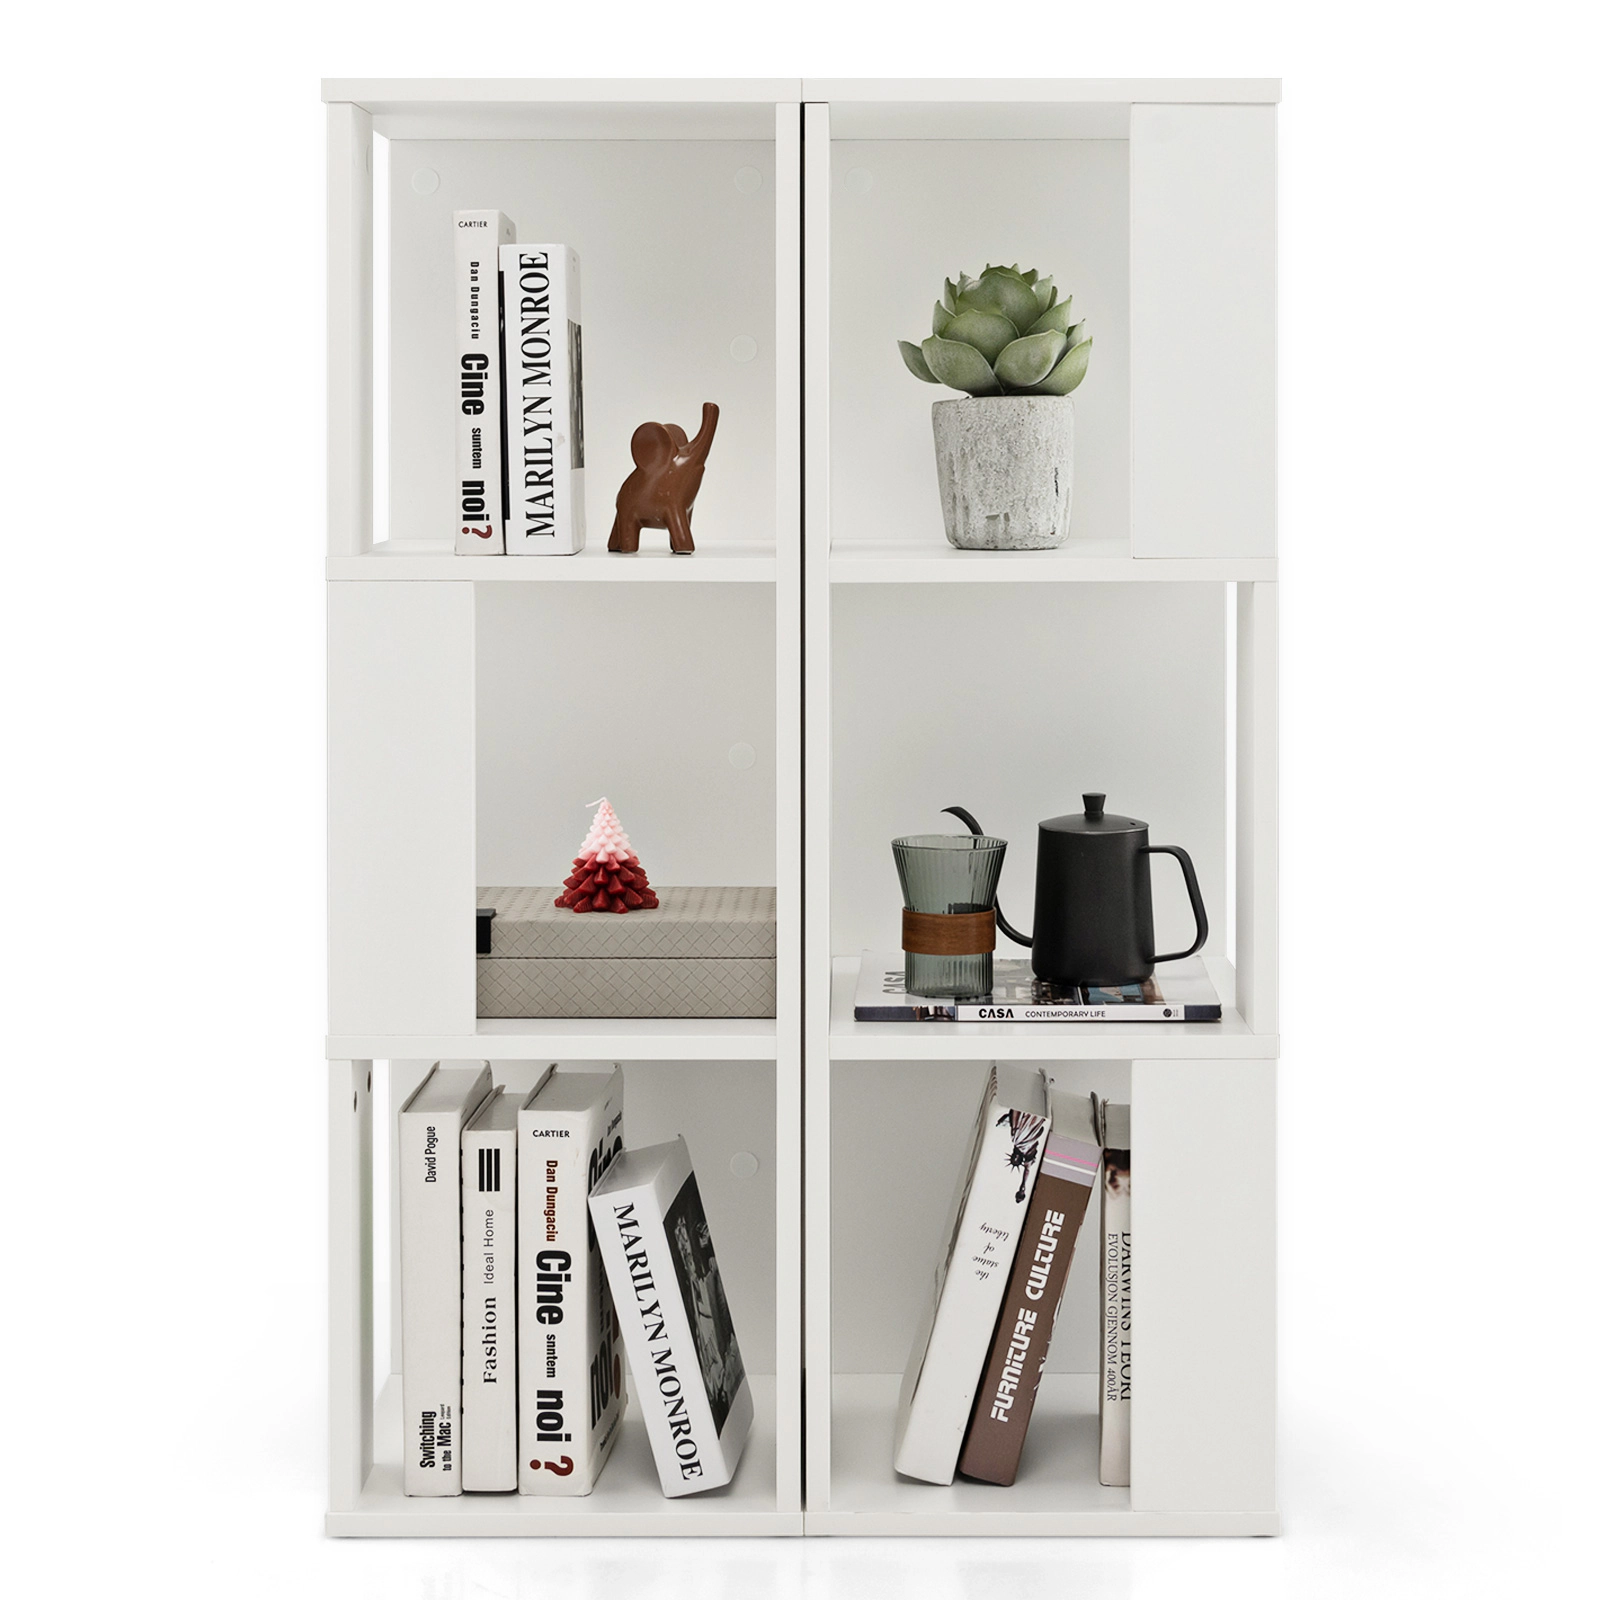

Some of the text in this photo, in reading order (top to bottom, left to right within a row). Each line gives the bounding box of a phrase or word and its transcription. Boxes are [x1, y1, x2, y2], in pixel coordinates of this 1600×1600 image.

[458, 220, 488, 229] CARTIER
[469, 261, 481, 340] Dan Dungaciu
[460, 353, 489, 416] Cine
[519, 251, 555, 538] MARILYN MONROE
[471, 427, 482, 469] suntem
[978, 1008, 1106, 1019] CASA CONTEMPORARY LIFE
[424, 1126, 439, 1183] David Pogue
[532, 1129, 570, 1138] CARTIER
[543, 1160, 559, 1242] Dan Dungaciu
[971, 1255, 1000, 1269] statue
[974, 1269, 990, 1281] the
[983, 1242, 996, 1255] of
[1024, 1208, 1066, 1301] CULTURE
[1104, 1232, 1119, 1302] EVOLUSJON
[481, 1209, 498, 1384] Fashion Ideal Home
[535, 1249, 572, 1325] Cine
[613, 1202, 704, 1481] MARILYN MONROE
[1104, 1305, 1119, 1365] GJENNOM
[418, 1411, 437, 1468] Switching
[436, 1422, 452, 1472] to the Mac
